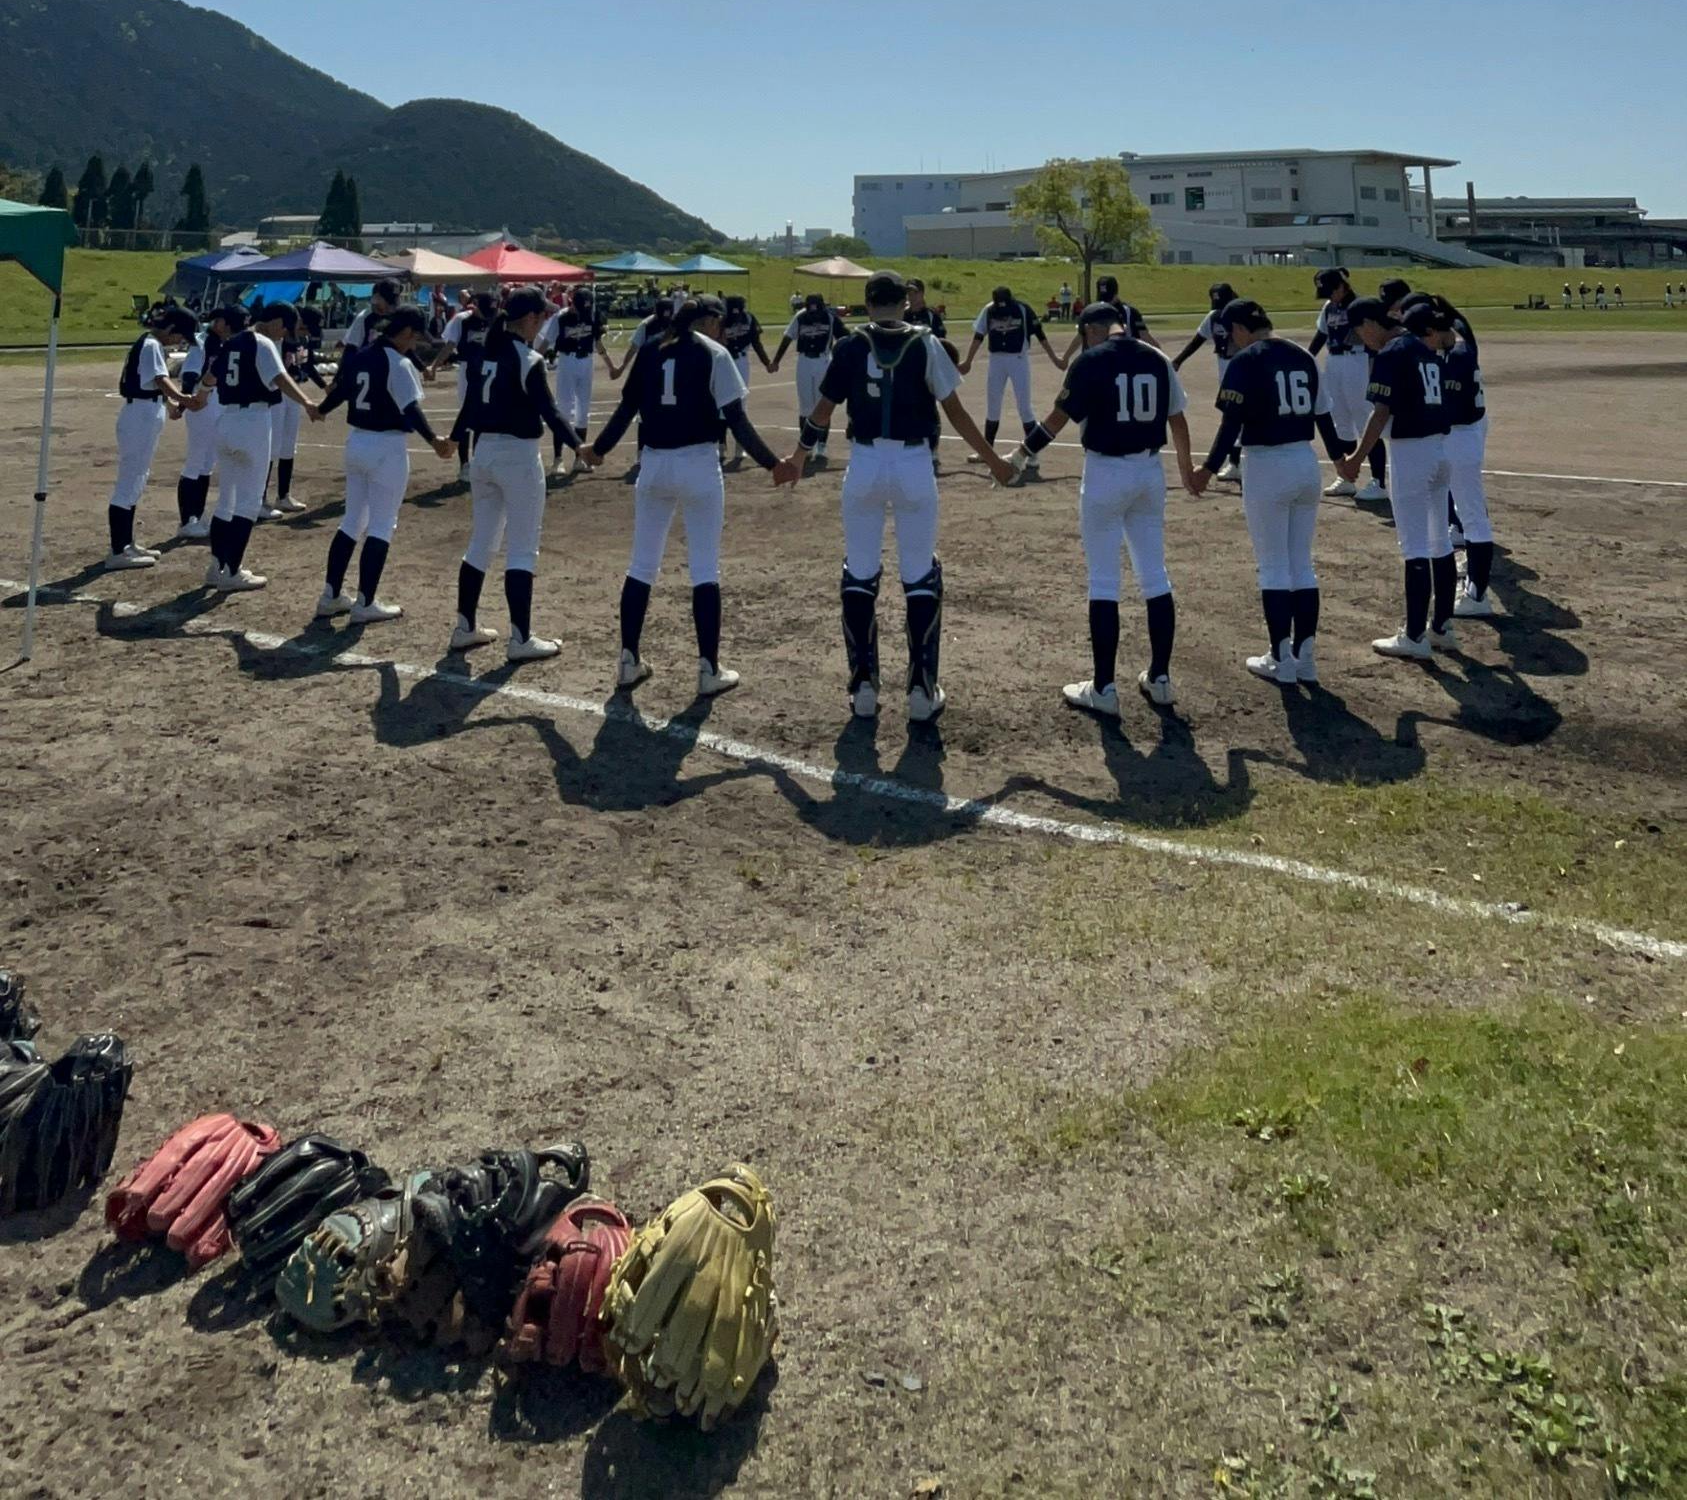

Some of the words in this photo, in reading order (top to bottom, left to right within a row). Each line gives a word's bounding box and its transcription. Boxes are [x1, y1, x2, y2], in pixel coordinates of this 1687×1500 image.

[226, 351, 241, 387] 5
[355, 371, 371, 411] 2
[481, 360, 498, 404] 7
[661, 358, 677, 405] 1
[1418, 362, 1442, 405] 18
[1115, 372, 1158, 422] 10
[1275, 370, 1312, 416] 16
